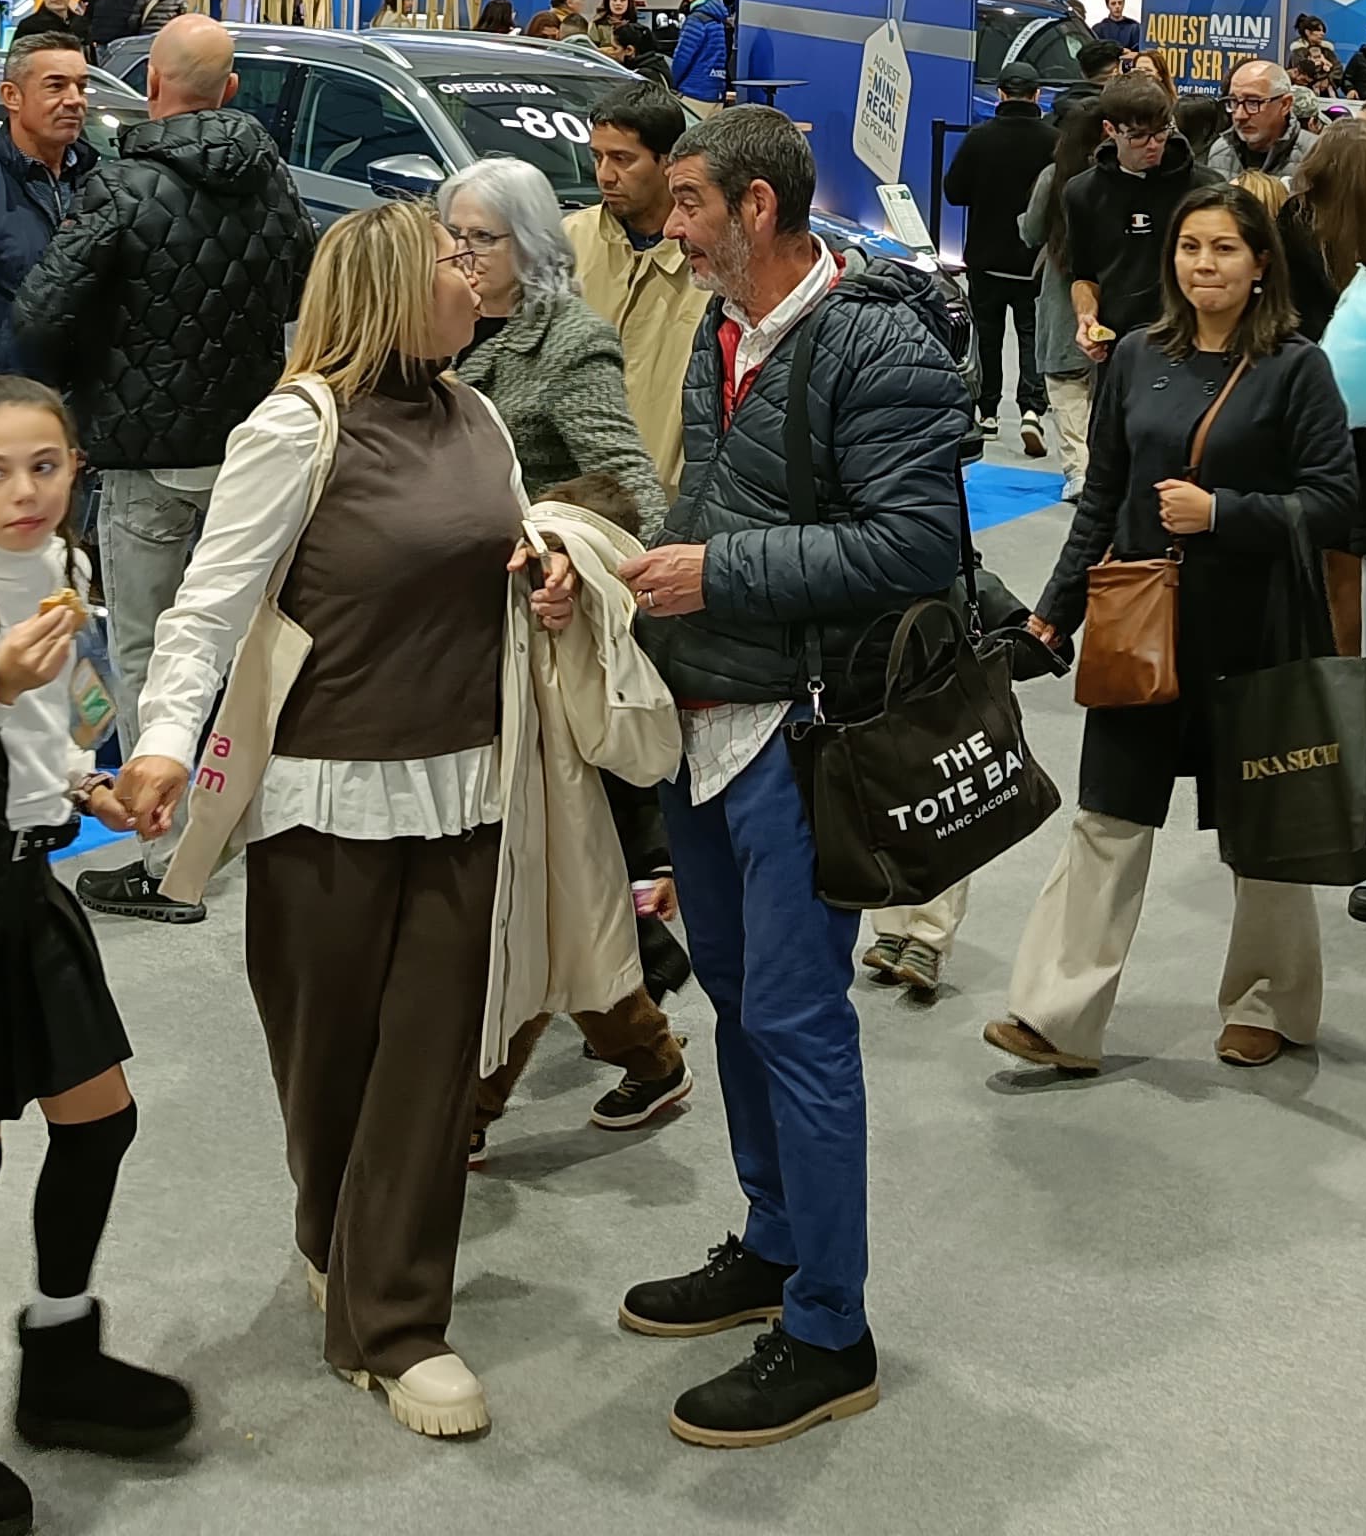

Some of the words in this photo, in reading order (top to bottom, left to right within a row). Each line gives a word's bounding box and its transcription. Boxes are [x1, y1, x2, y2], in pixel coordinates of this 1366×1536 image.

[1145, 13, 1208, 47] AQUEST
[1209, 14, 1272, 39] MINI
[873, 52, 901, 85] AQUEST
[1191, 49, 1223, 81] SER
[438, 82, 512, 95] OFERTA
[515, 83, 557, 96] FIRA
[872, 71, 897, 108] MINI
[865, 90, 897, 133] REGAL
[932, 730, 993, 780] THE
[887, 776, 979, 832] TOTE
[982, 740, 1026, 791] BA
[935, 812, 973, 840] MARC
[974, 783, 1020, 820] JACOBS
